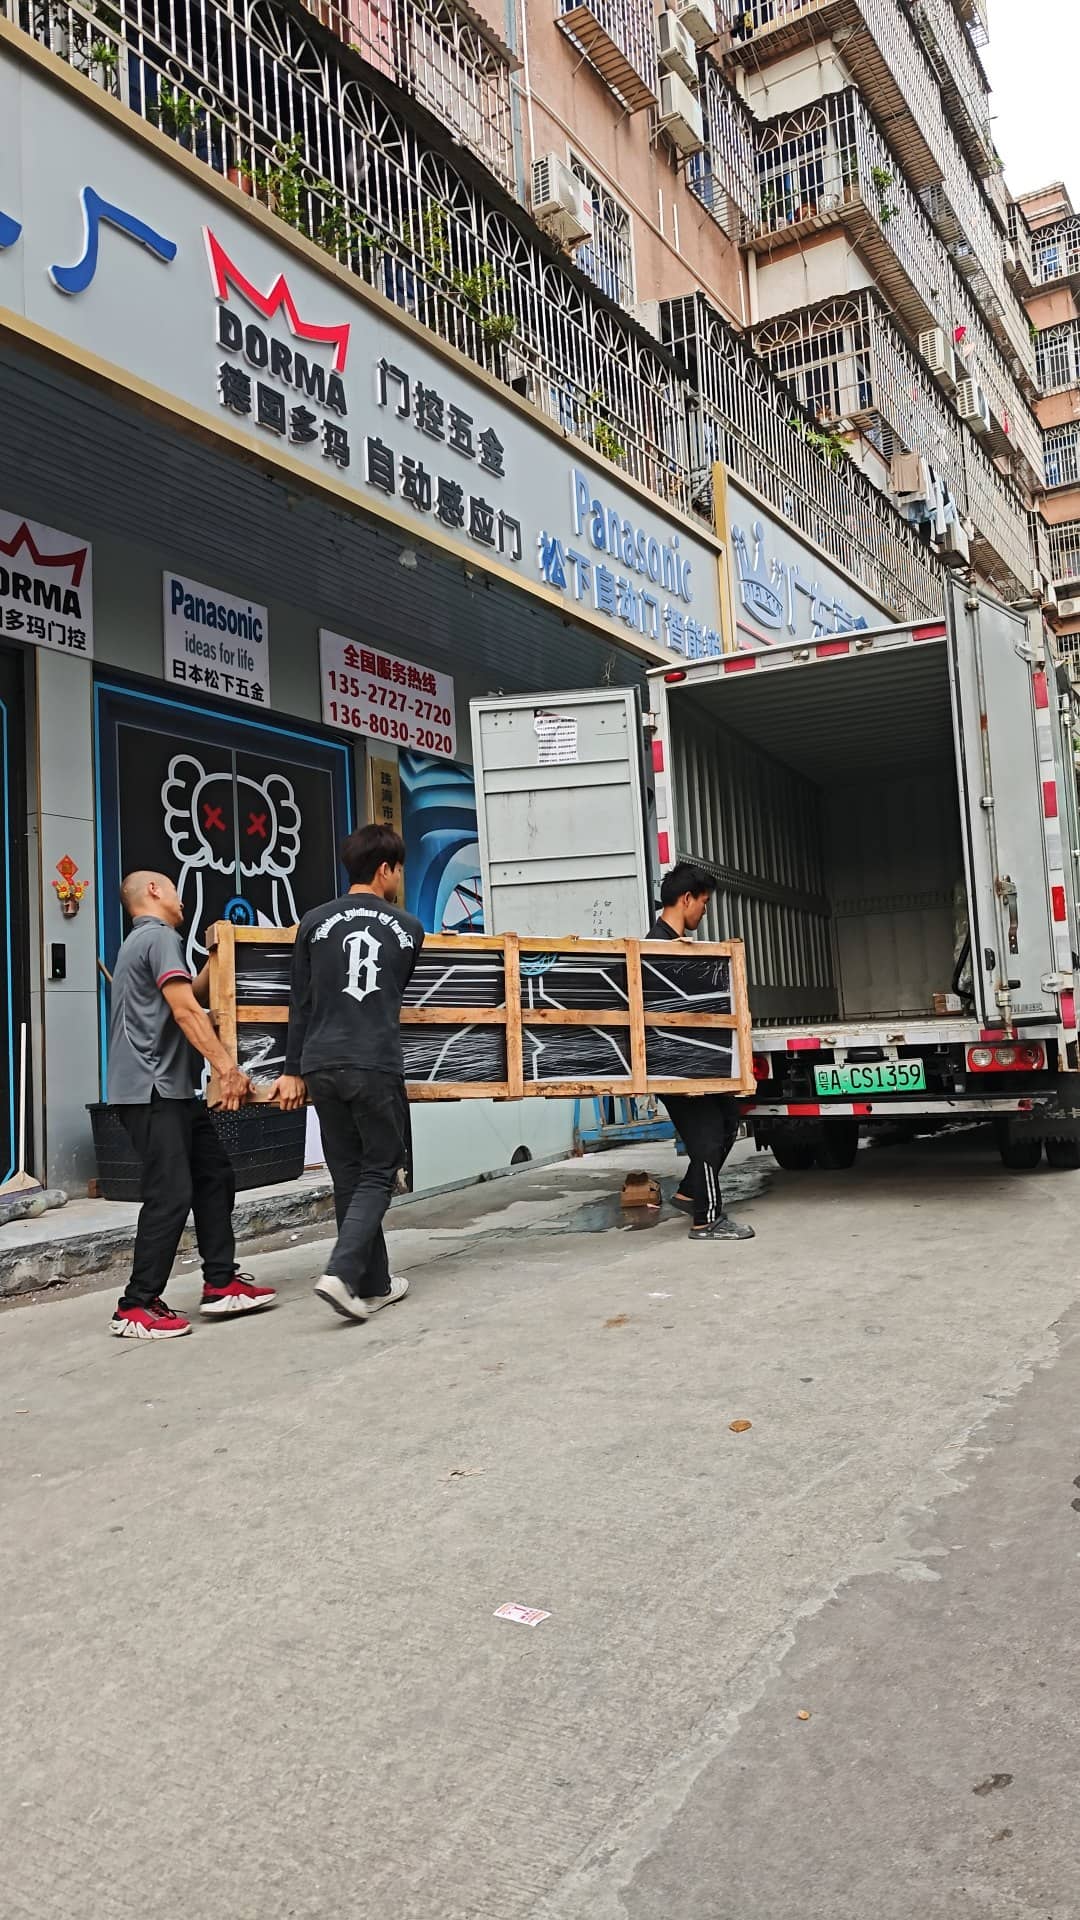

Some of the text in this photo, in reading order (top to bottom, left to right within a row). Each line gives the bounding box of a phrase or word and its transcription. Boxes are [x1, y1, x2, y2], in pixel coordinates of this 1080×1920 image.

[216, 305, 348, 417] DORMA
[217, 361, 349, 468] 德国多玛
[377, 357, 505, 477] 门控五金
[365, 436, 522, 561] 自动感应门
[570, 468, 694, 603] Panasonic
[0, 606, 86, 651] 多玛门控
[171, 579, 263, 643] Panasonic
[173, 659, 264, 702] 日本松下五金
[185, 630, 254, 672] ideas for life
[343, 644, 437, 696] 全国服务热线
[328, 670, 451, 726] 135-2727-2720
[329, 701, 452, 754] 136-8030-2020
